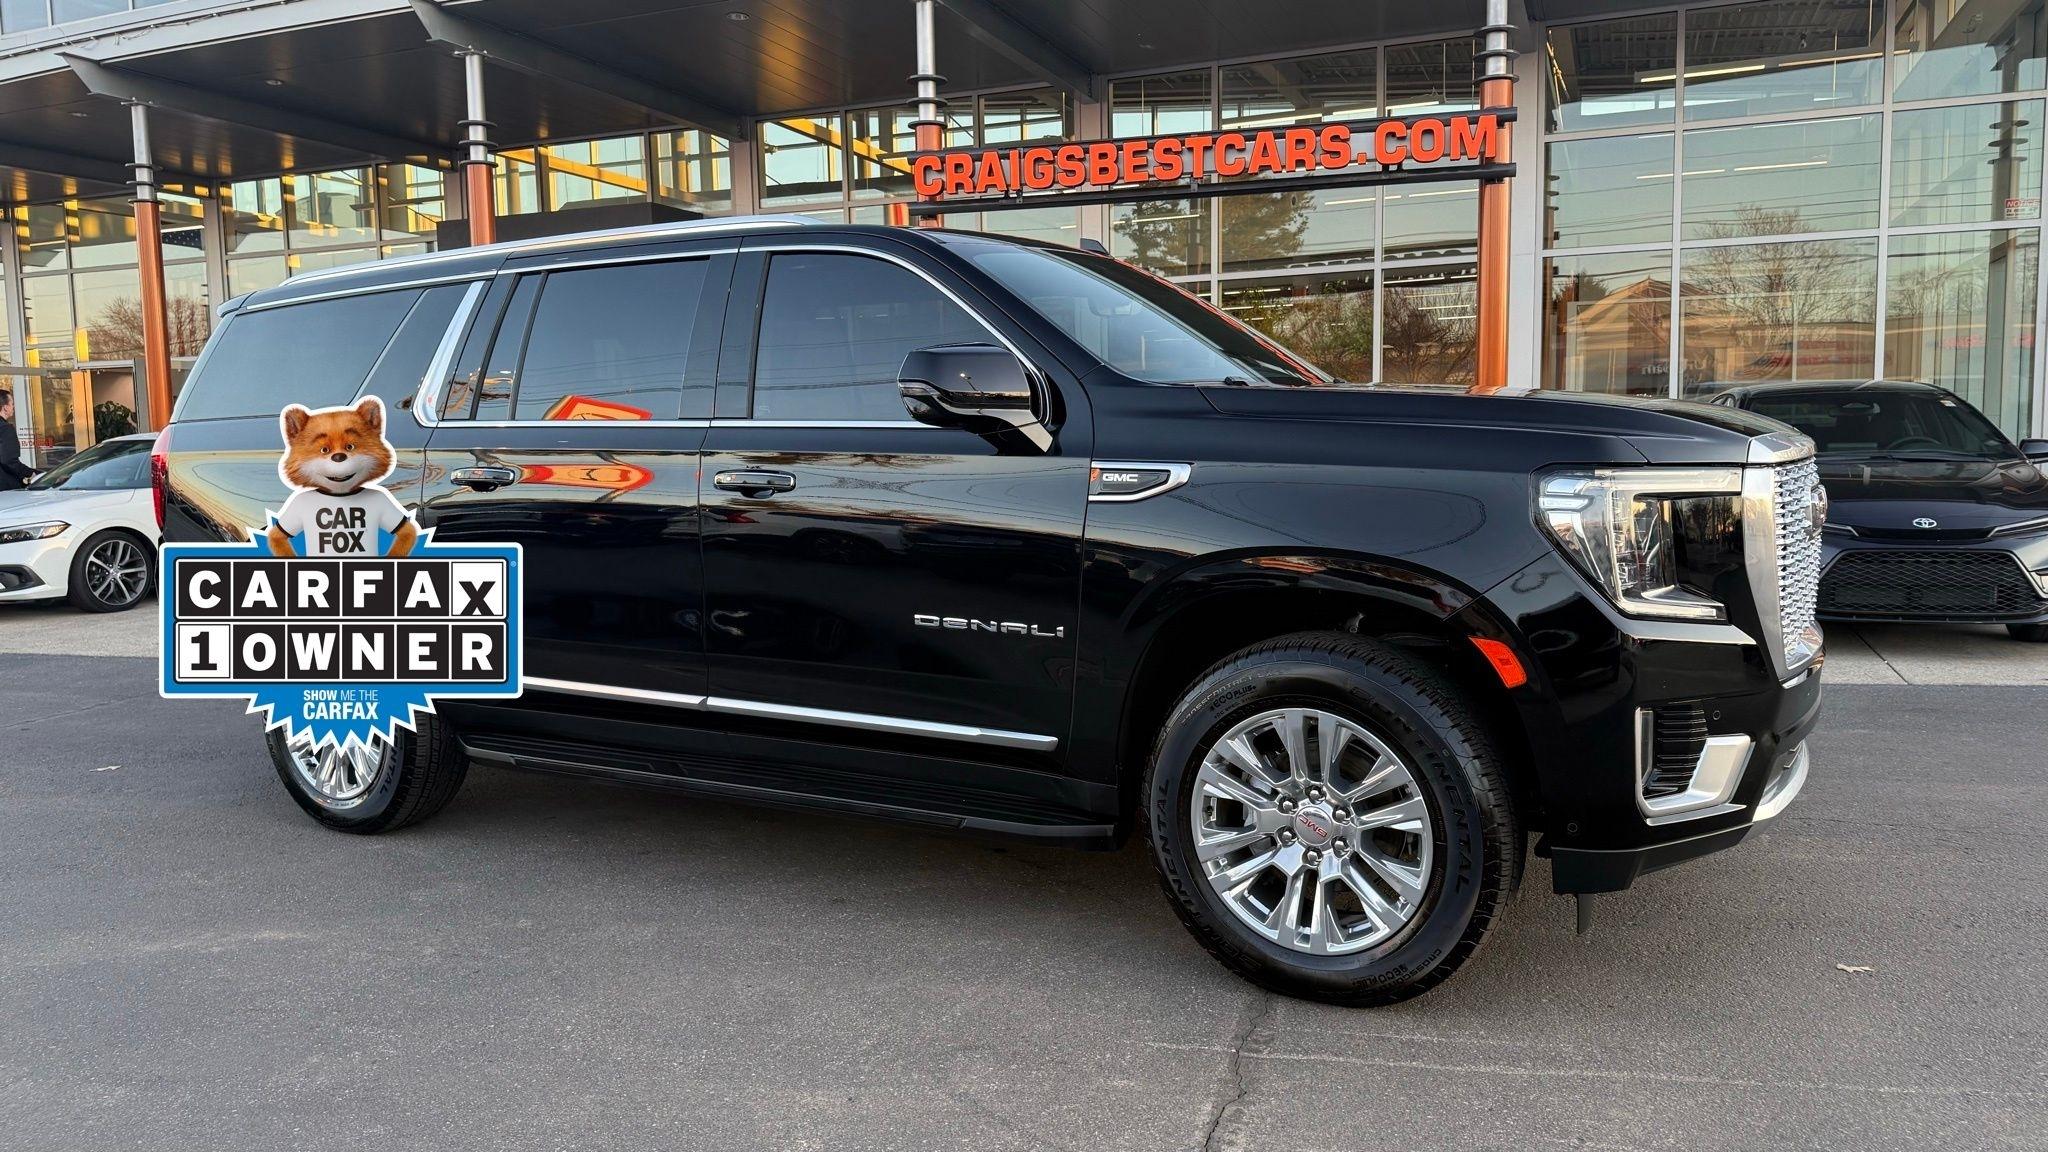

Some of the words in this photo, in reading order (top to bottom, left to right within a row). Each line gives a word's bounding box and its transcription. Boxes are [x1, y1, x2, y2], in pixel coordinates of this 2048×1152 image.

[913, 114, 1498, 197] CRAIGSBESTCARS.COM
[1102, 472, 1139, 482] GMC
[914, 614, 1064, 639] DENALI
[1298, 813, 1328, 838] GMC
